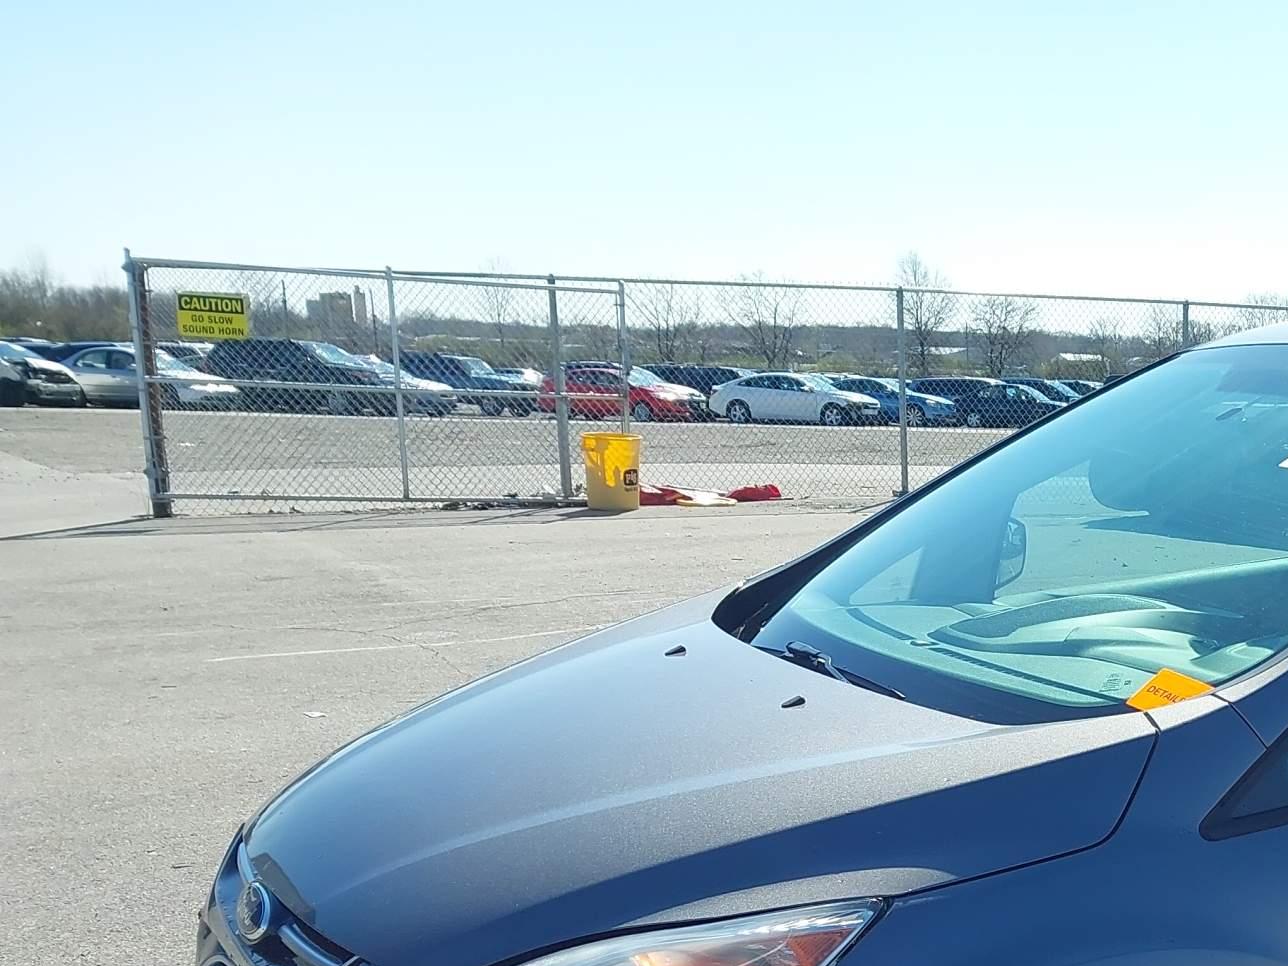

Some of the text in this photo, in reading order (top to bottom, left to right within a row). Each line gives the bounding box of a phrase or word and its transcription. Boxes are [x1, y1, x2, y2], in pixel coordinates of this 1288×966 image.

[180, 296, 242, 313] CAUTION
[191, 314, 233, 325] GO SLOW
[182, 324, 244, 336] SOUND HORN
